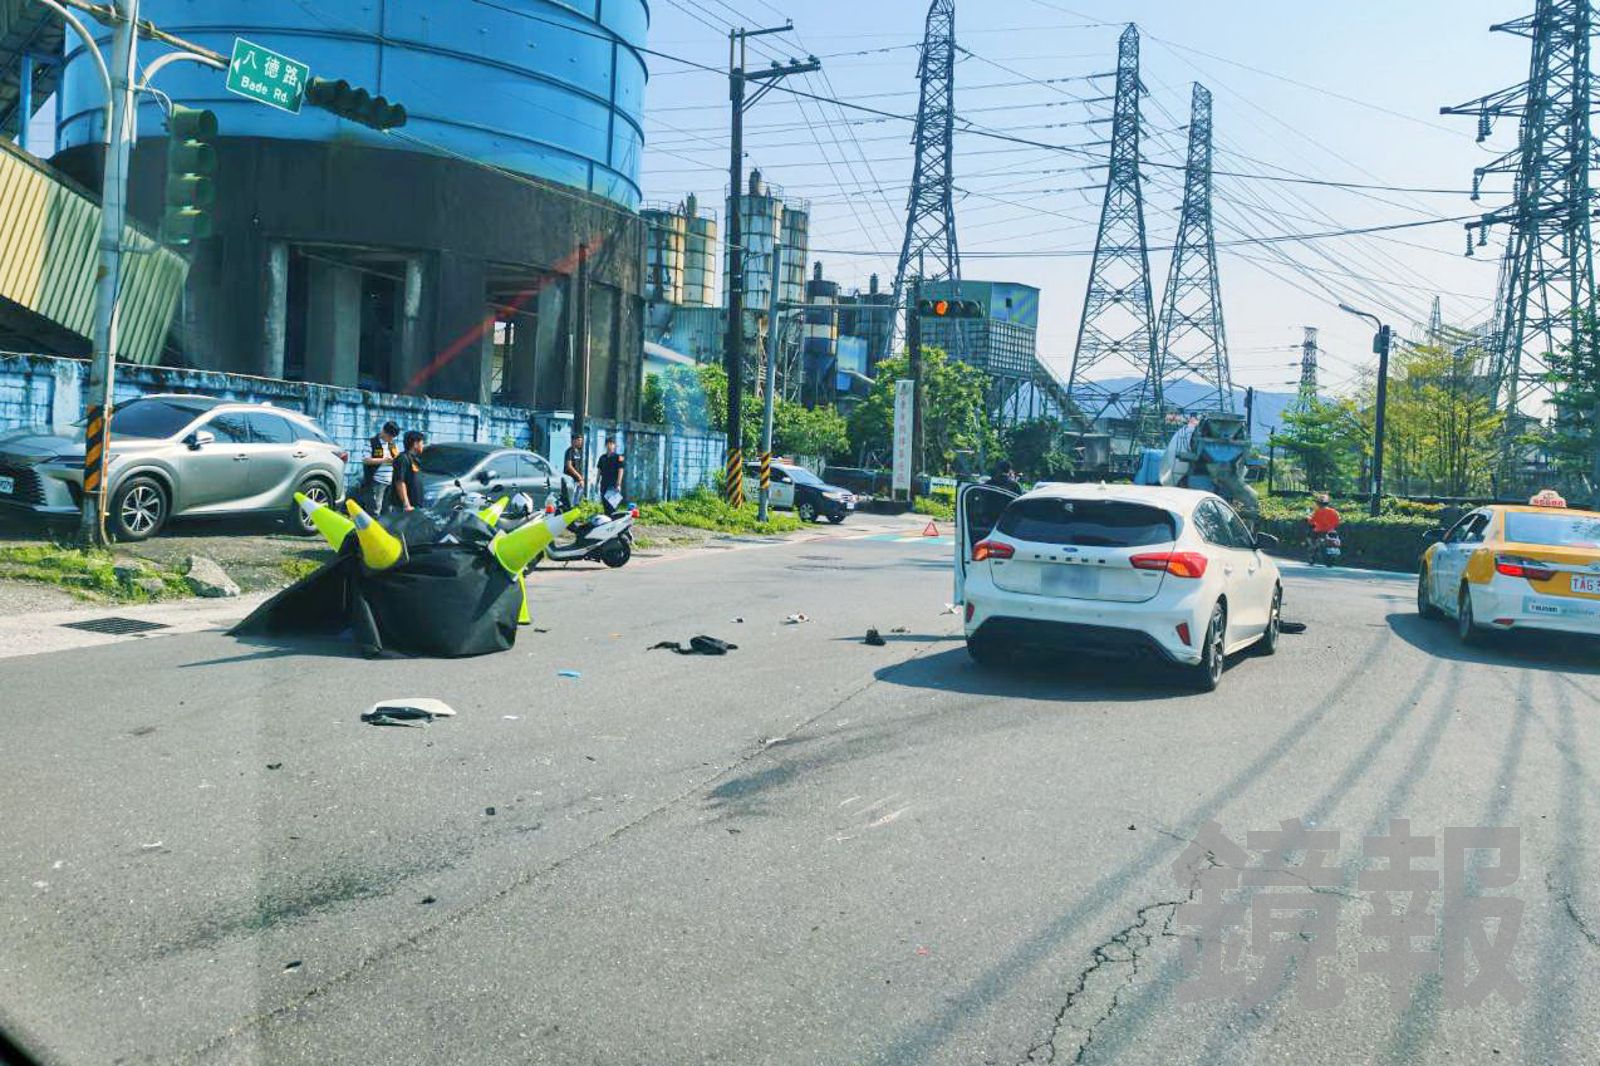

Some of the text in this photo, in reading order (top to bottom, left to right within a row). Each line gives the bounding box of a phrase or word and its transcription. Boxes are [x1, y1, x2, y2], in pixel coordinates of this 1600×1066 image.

[242, 51, 298, 86] 八德路
[242, 76, 289, 103] Bade Rd.
